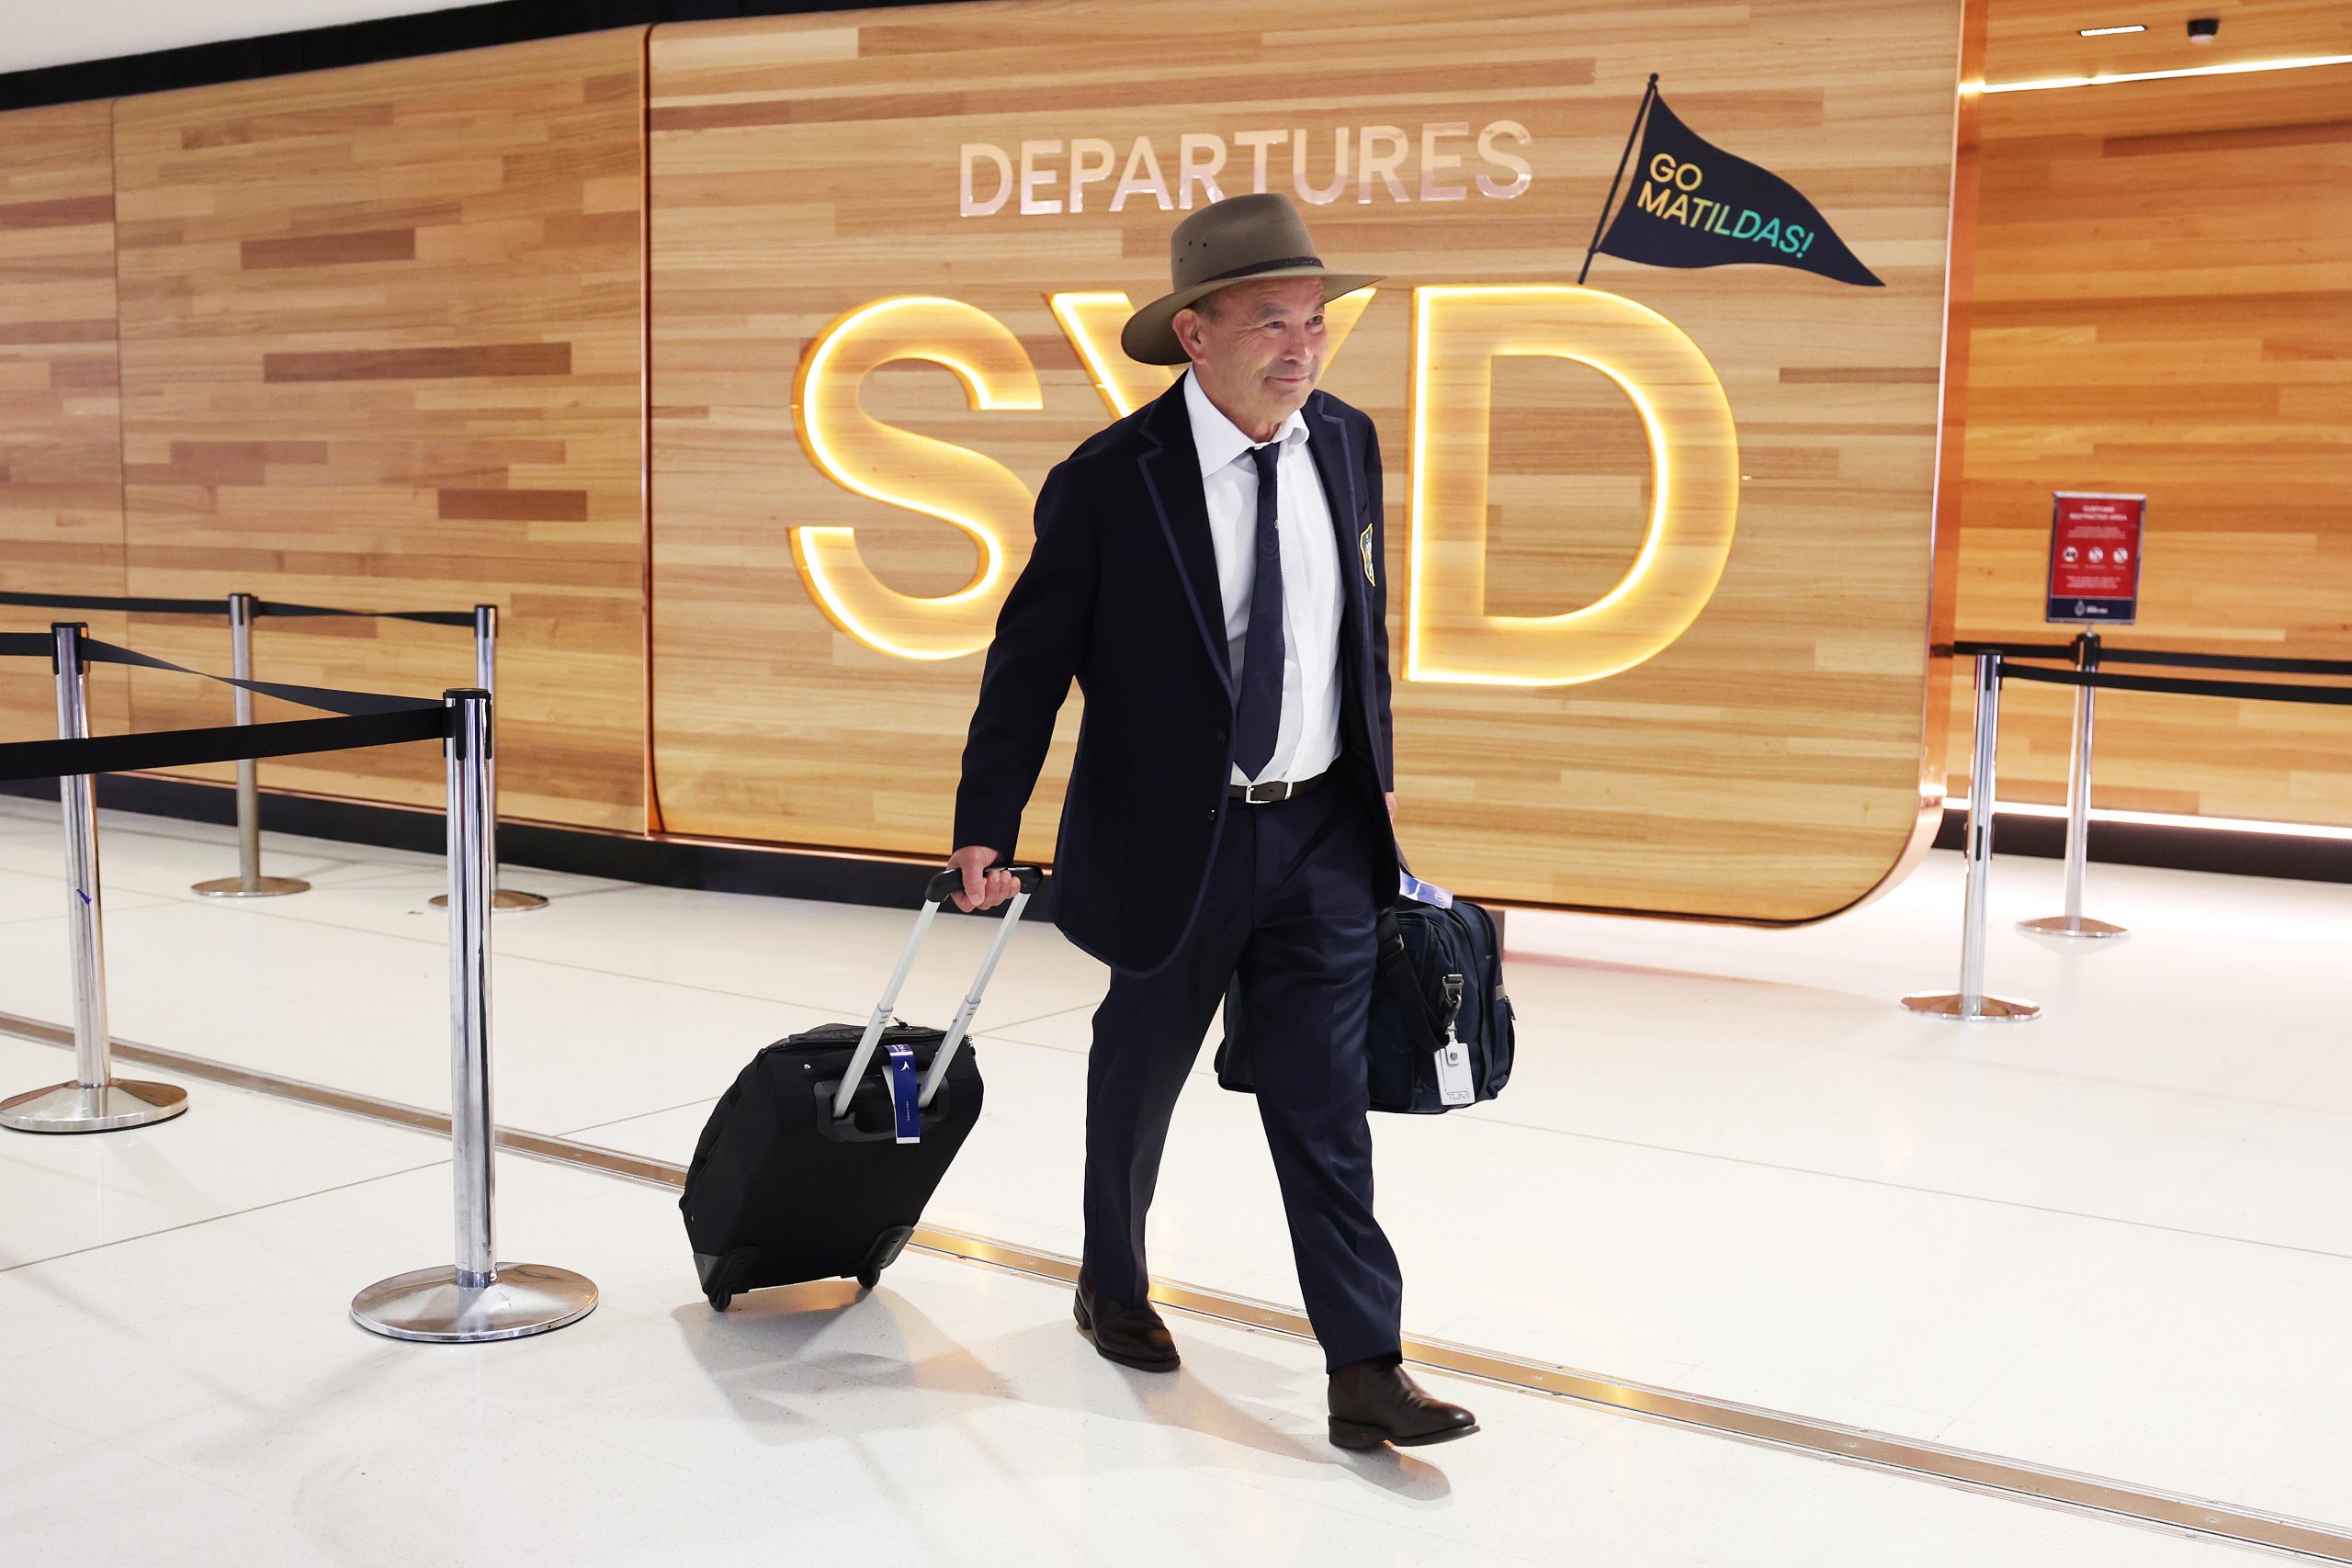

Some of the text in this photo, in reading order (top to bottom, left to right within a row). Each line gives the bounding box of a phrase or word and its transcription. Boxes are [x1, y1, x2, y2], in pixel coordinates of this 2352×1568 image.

[959, 119, 1533, 217] DEPARTURES
[1649, 152, 1703, 191] GO
[1636, 180, 1815, 258] MATILDAS!
